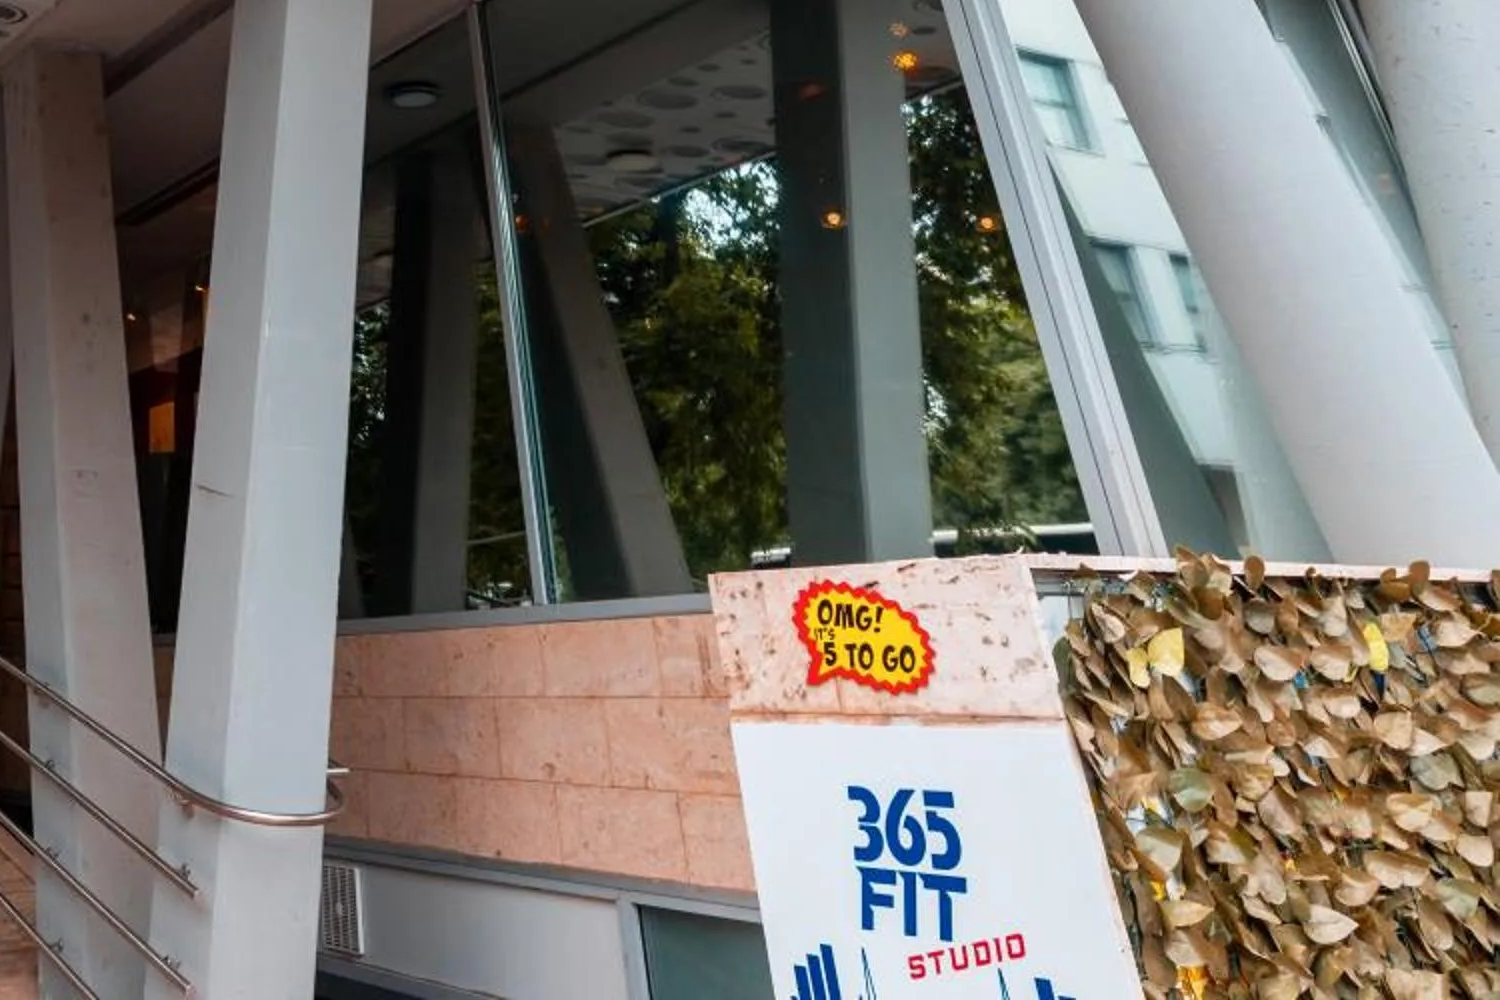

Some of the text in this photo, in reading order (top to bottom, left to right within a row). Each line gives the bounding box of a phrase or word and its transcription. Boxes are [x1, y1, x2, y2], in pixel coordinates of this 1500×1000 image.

[817, 599, 884, 633] OMG!
[823, 641, 916, 674] 5 TO GO
[847, 785, 963, 871] 365
[855, 866, 968, 942] FIT
[907, 933, 1027, 981] STUDIO
